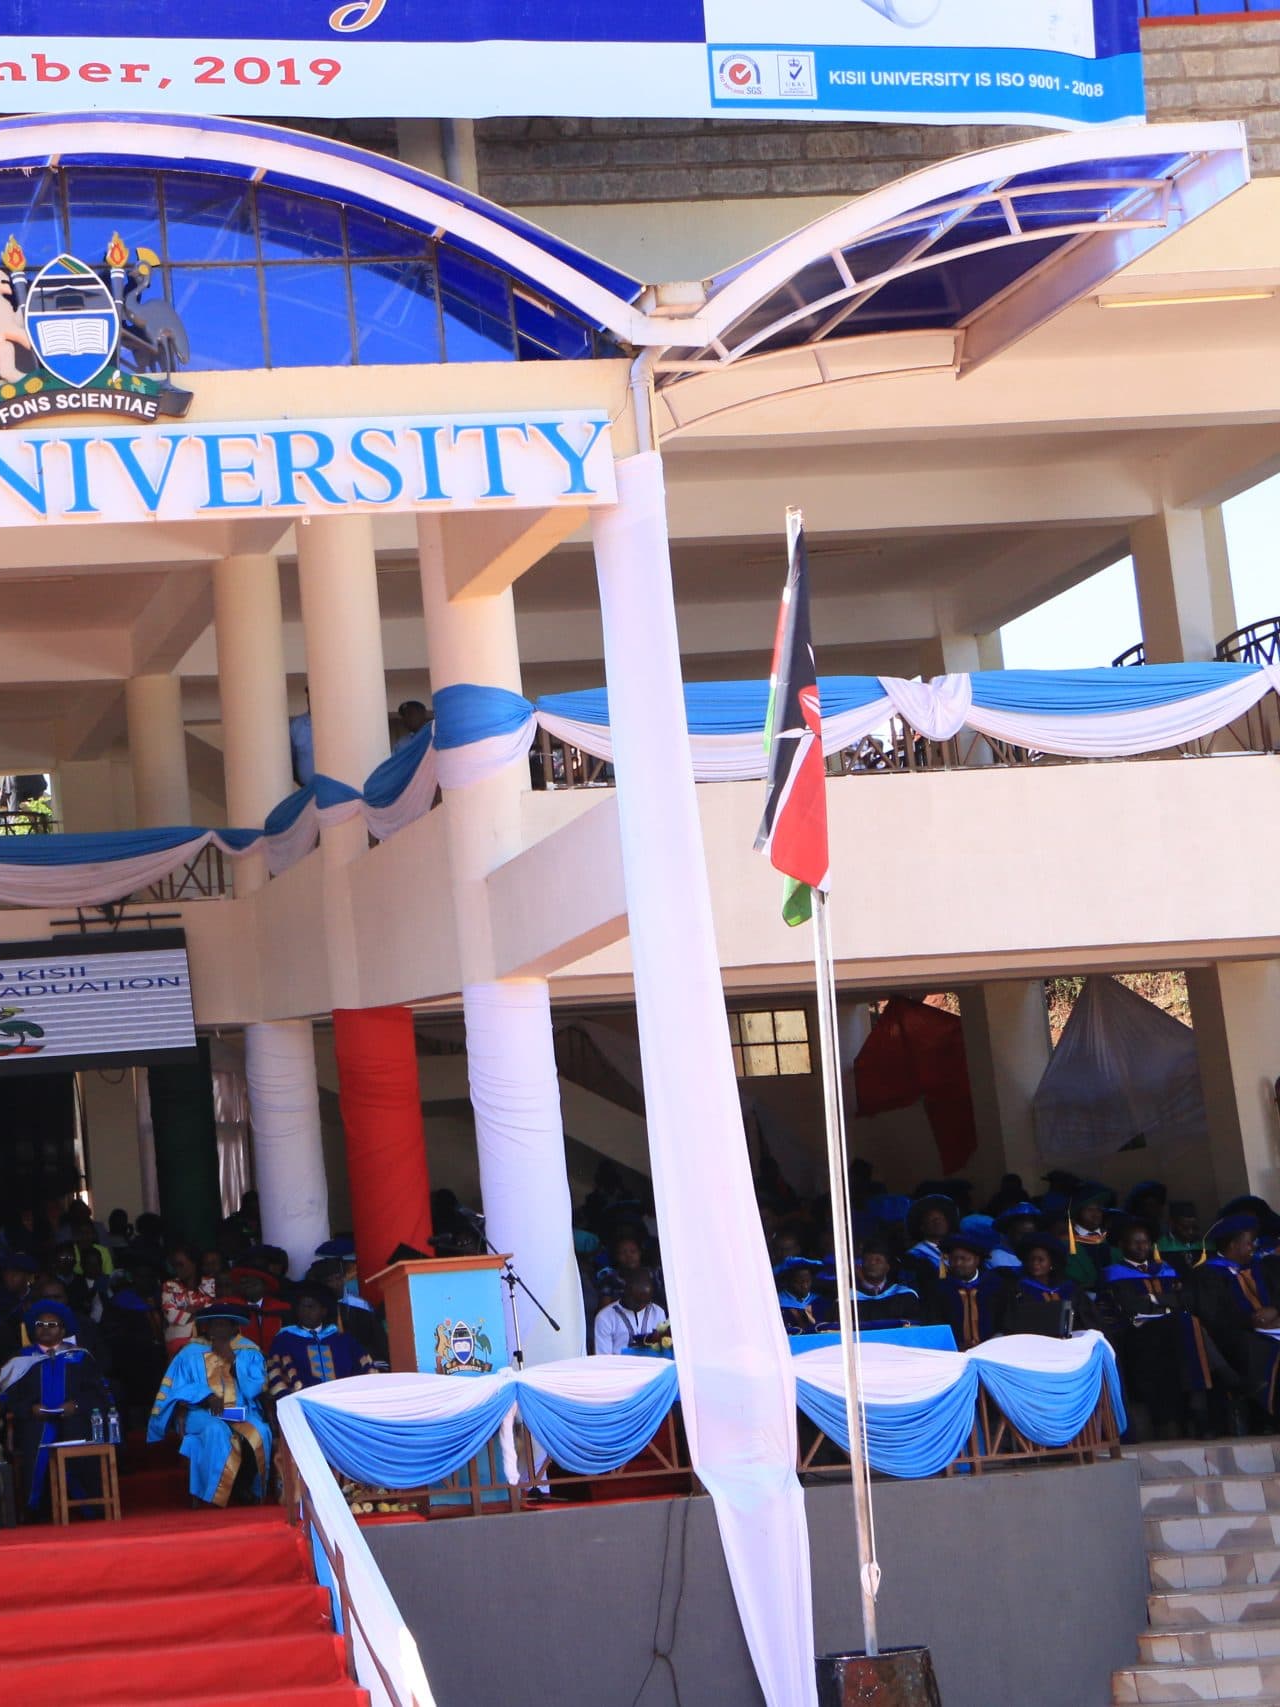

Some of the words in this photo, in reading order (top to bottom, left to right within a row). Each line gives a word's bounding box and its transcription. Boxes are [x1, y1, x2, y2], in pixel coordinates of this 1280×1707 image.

[193, 56, 343, 86] 2019
[829, 70, 867, 86] KISII
[871, 71, 971, 88] UNIVERSITY
[975, 72, 992, 87] IS
[996, 73, 1025, 88] ISO
[1028, 74, 1061, 91] 9001
[1072, 81, 1105, 98] 2008
[746, 87, 762, 95] SGS
[55, 392, 158, 418] SCIENTIAE
[18, 966, 86, 982] KISII
